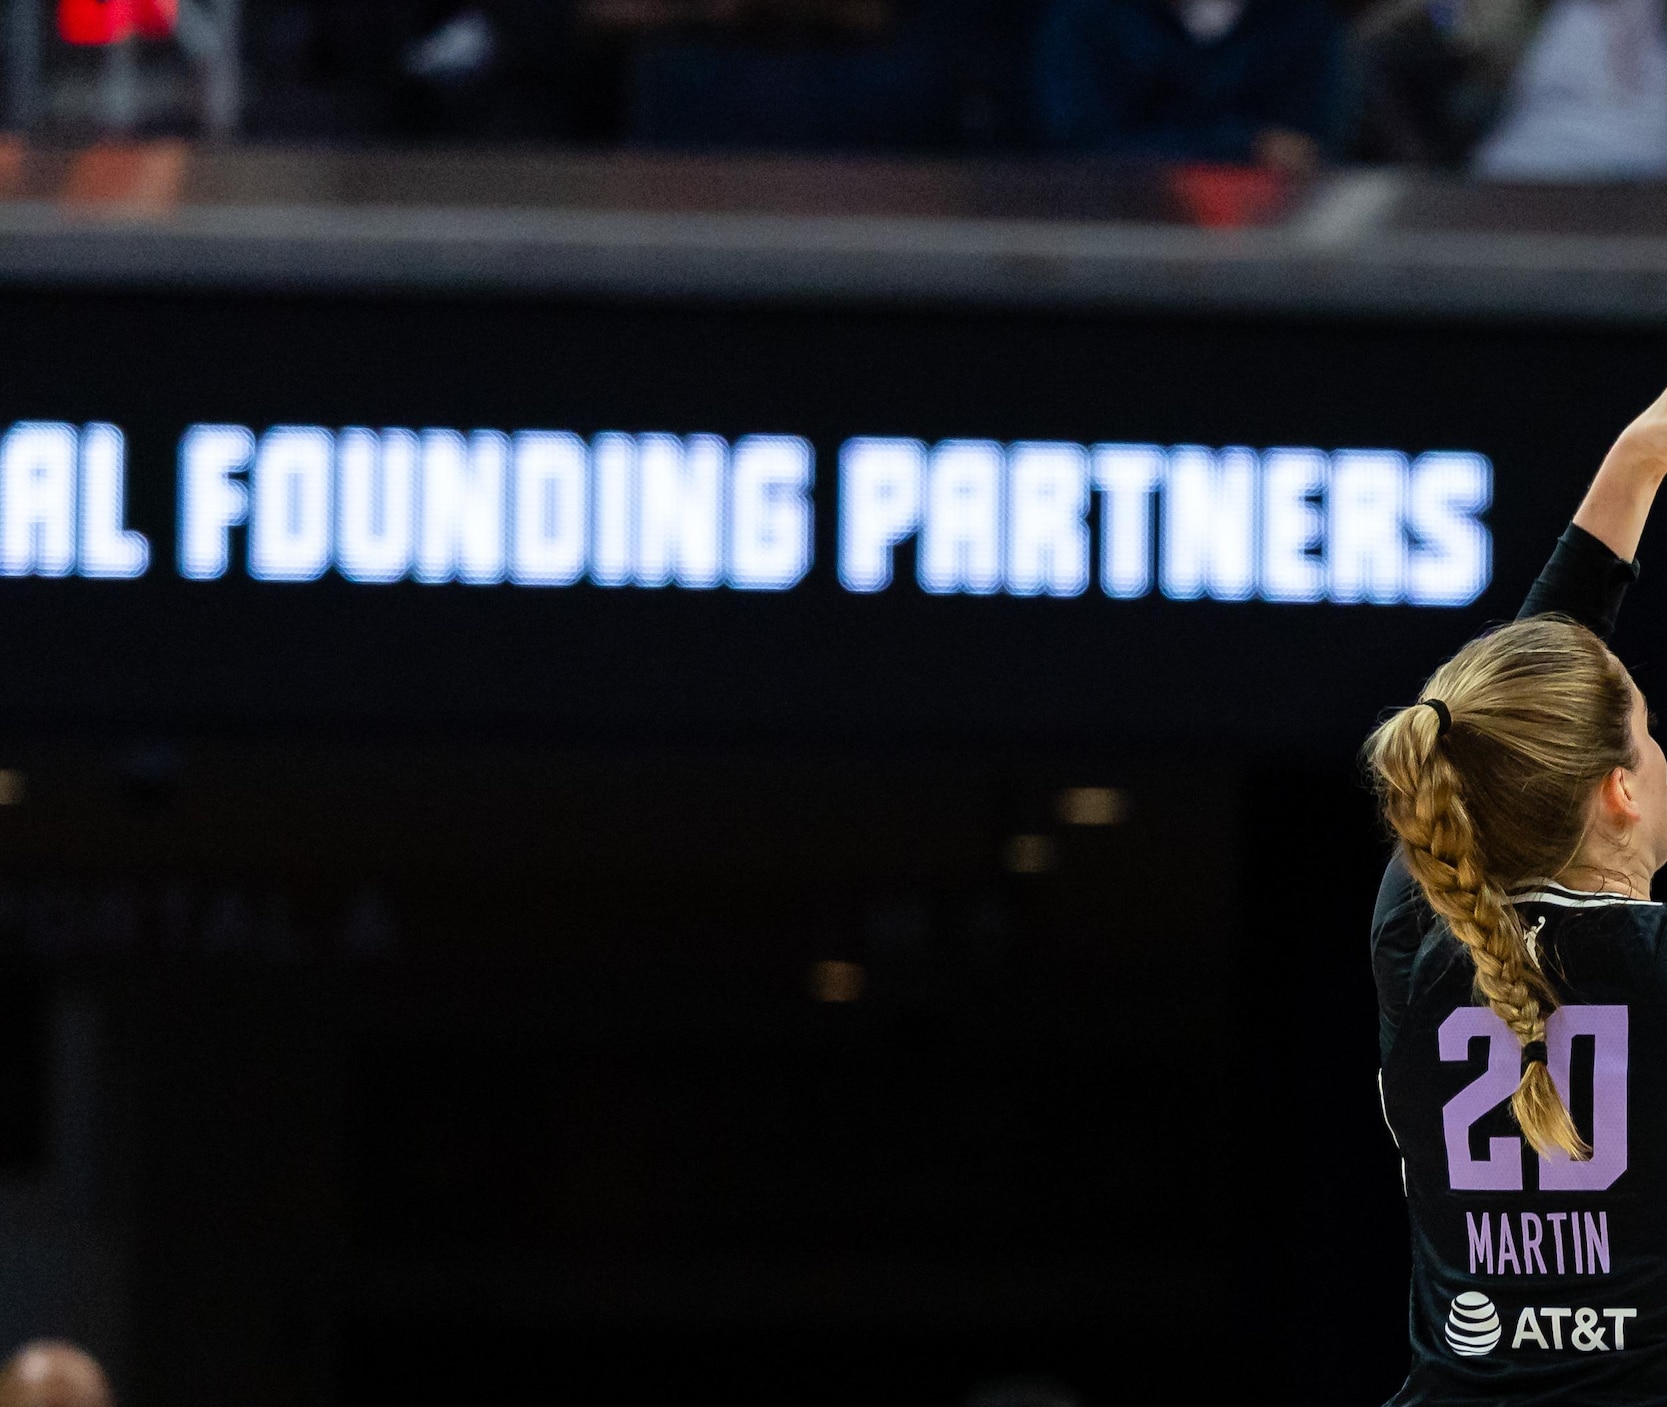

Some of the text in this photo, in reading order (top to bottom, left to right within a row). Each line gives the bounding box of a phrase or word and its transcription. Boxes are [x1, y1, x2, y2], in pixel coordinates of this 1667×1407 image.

[0, 421, 1494, 606] AL FOUNDING PARTNERS
[1438, 1005, 1628, 1191] 20
[1466, 1211, 1611, 1275] MARTIN
[1511, 1306, 1637, 1352] AT&T
